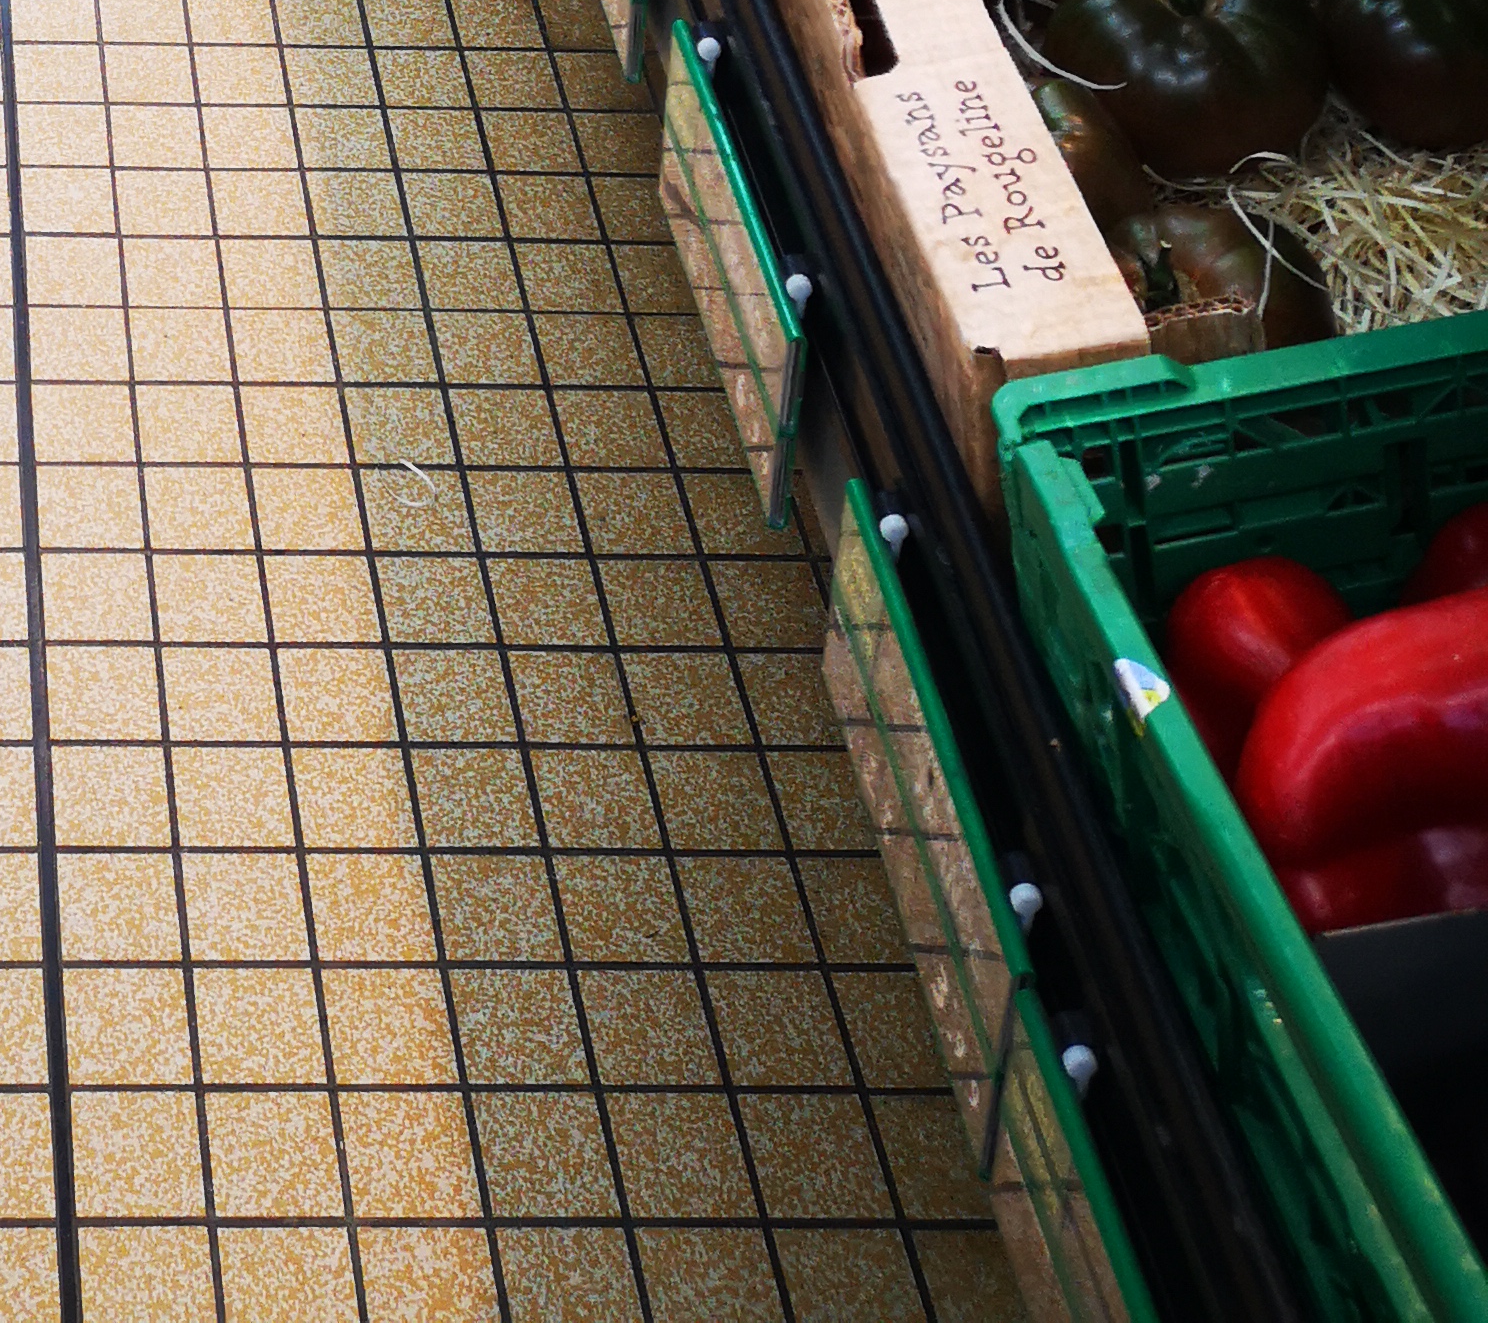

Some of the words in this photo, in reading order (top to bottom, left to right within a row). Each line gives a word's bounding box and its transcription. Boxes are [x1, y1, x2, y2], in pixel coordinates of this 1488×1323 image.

[898, 91, 983, 224] Paysans
[955, 79, 1045, 234] Rougeline
[961, 236, 1011, 293] Les
[1023, 245, 1066, 282] de
